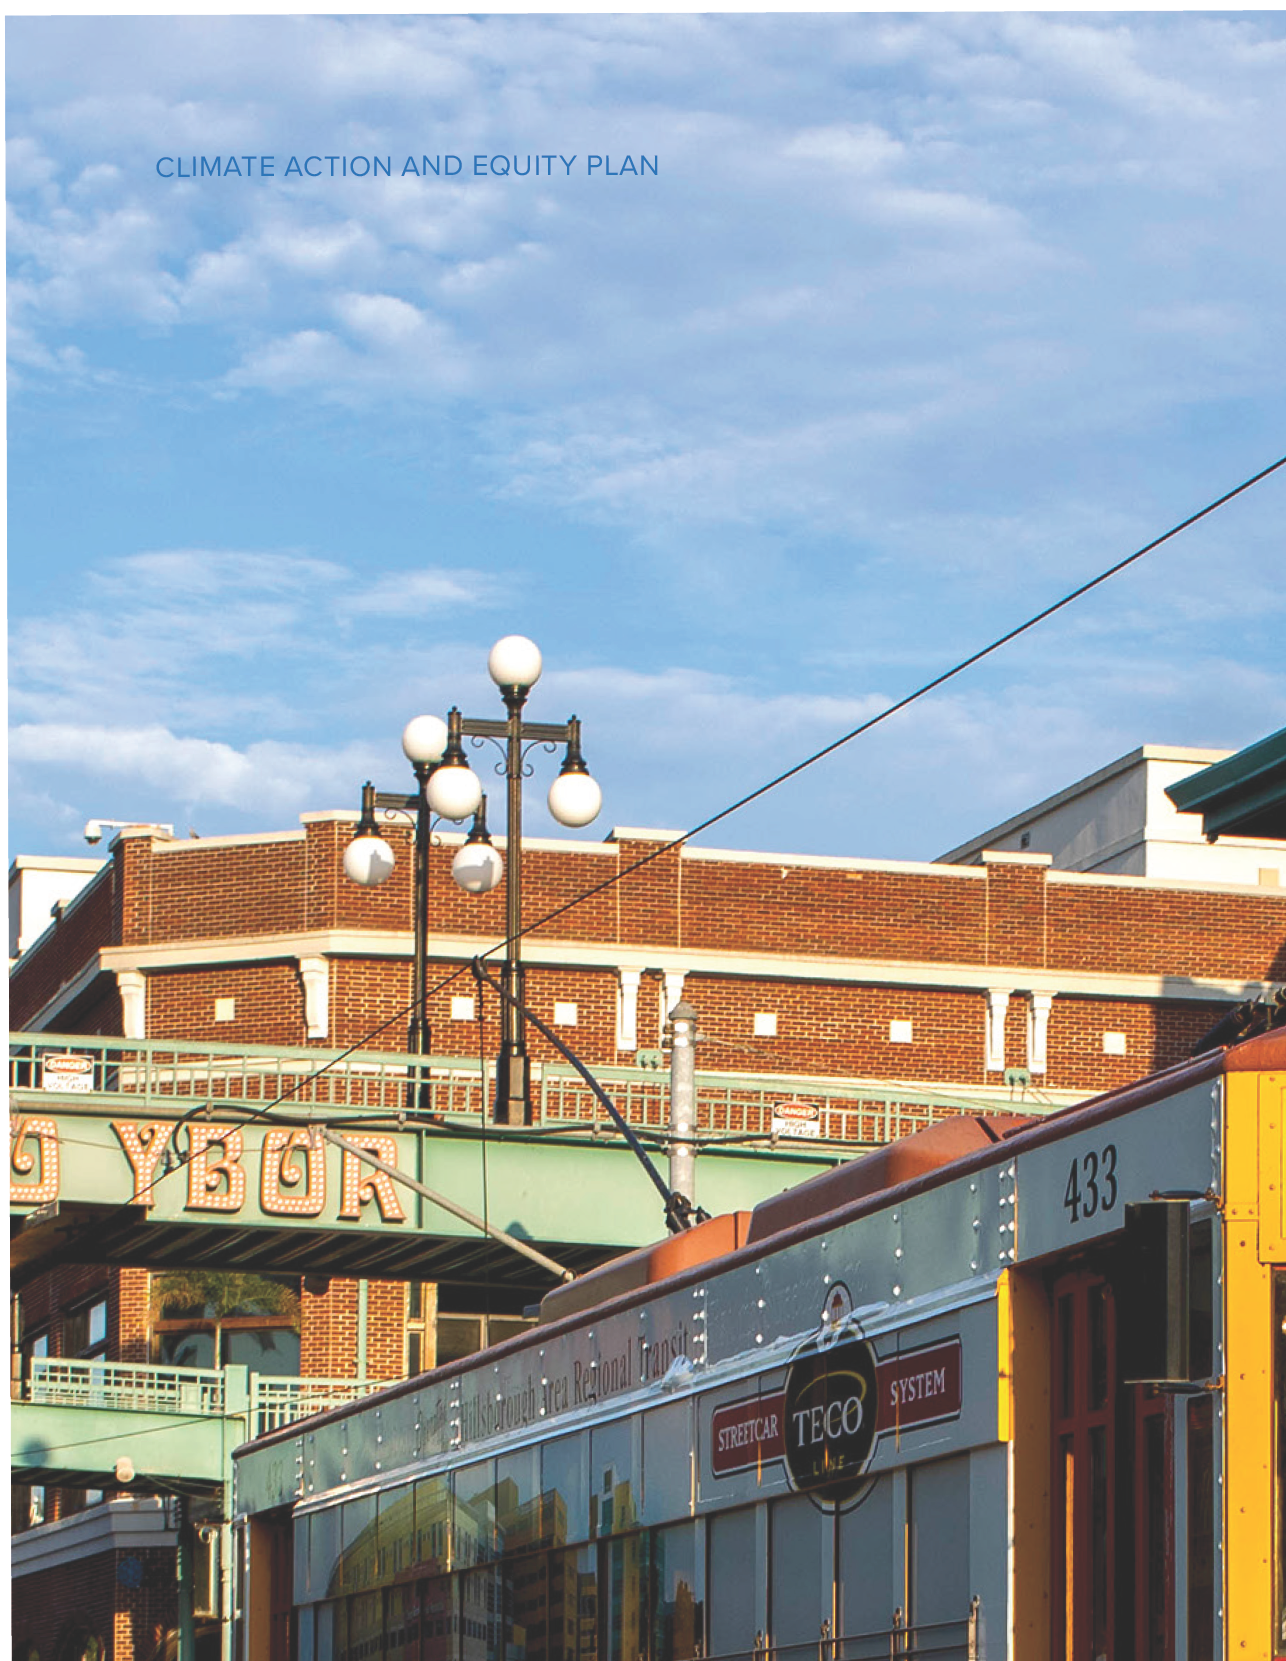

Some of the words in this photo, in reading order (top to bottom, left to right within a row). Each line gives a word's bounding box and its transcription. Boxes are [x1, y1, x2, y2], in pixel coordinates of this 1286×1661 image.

[50, 1061, 88, 1070] DANGER
[778, 1105, 815, 1117] DANGER
[784, 1120, 807, 1128] HIGH
[110, 1120, 407, 1223] YBOR
[1063, 1143, 1119, 1224] 433
[460, 1373, 537, 1443] Hillsborough
[573, 1337, 633, 1406] Regional
[638, 1321, 690, 1382] Transit
[889, 1366, 947, 1407] SYSTEM
[717, 1413, 779, 1452] STREETCAR
[792, 1395, 865, 1448] TECO
[812, 1454, 846, 1477] LINE
